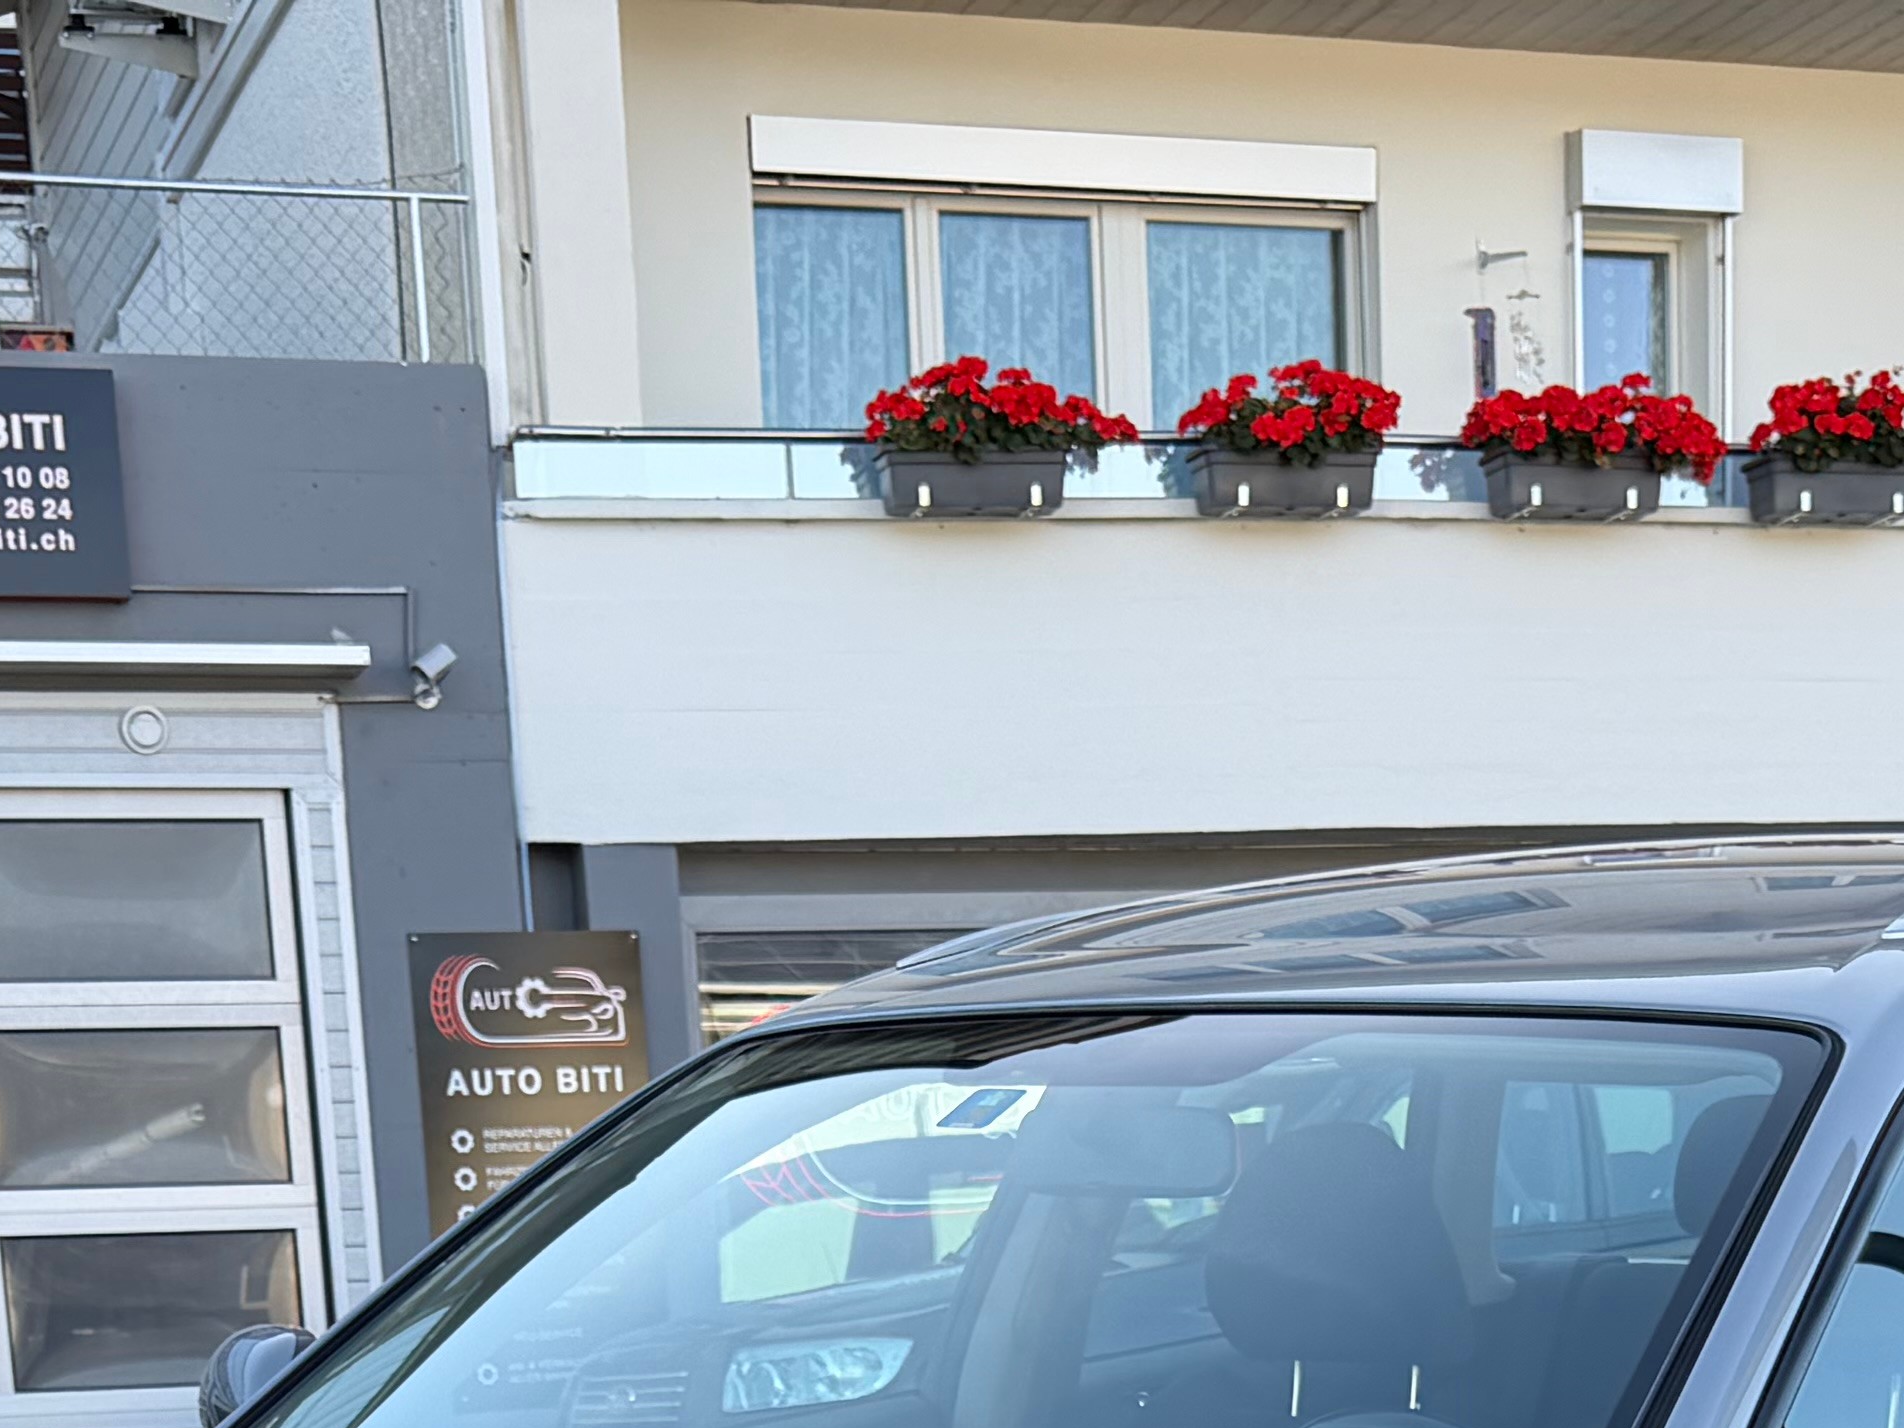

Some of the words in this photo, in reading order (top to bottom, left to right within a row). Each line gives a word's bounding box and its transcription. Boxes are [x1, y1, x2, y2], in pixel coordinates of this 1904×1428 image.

[2, 466, 32, 488] 10
[39, 467, 70, 489] 08
[4, 497, 35, 519] 26
[42, 498, 73, 520] 24
[447, 1067, 542, 1097] AUTO
[557, 1065, 624, 1093] BITI
